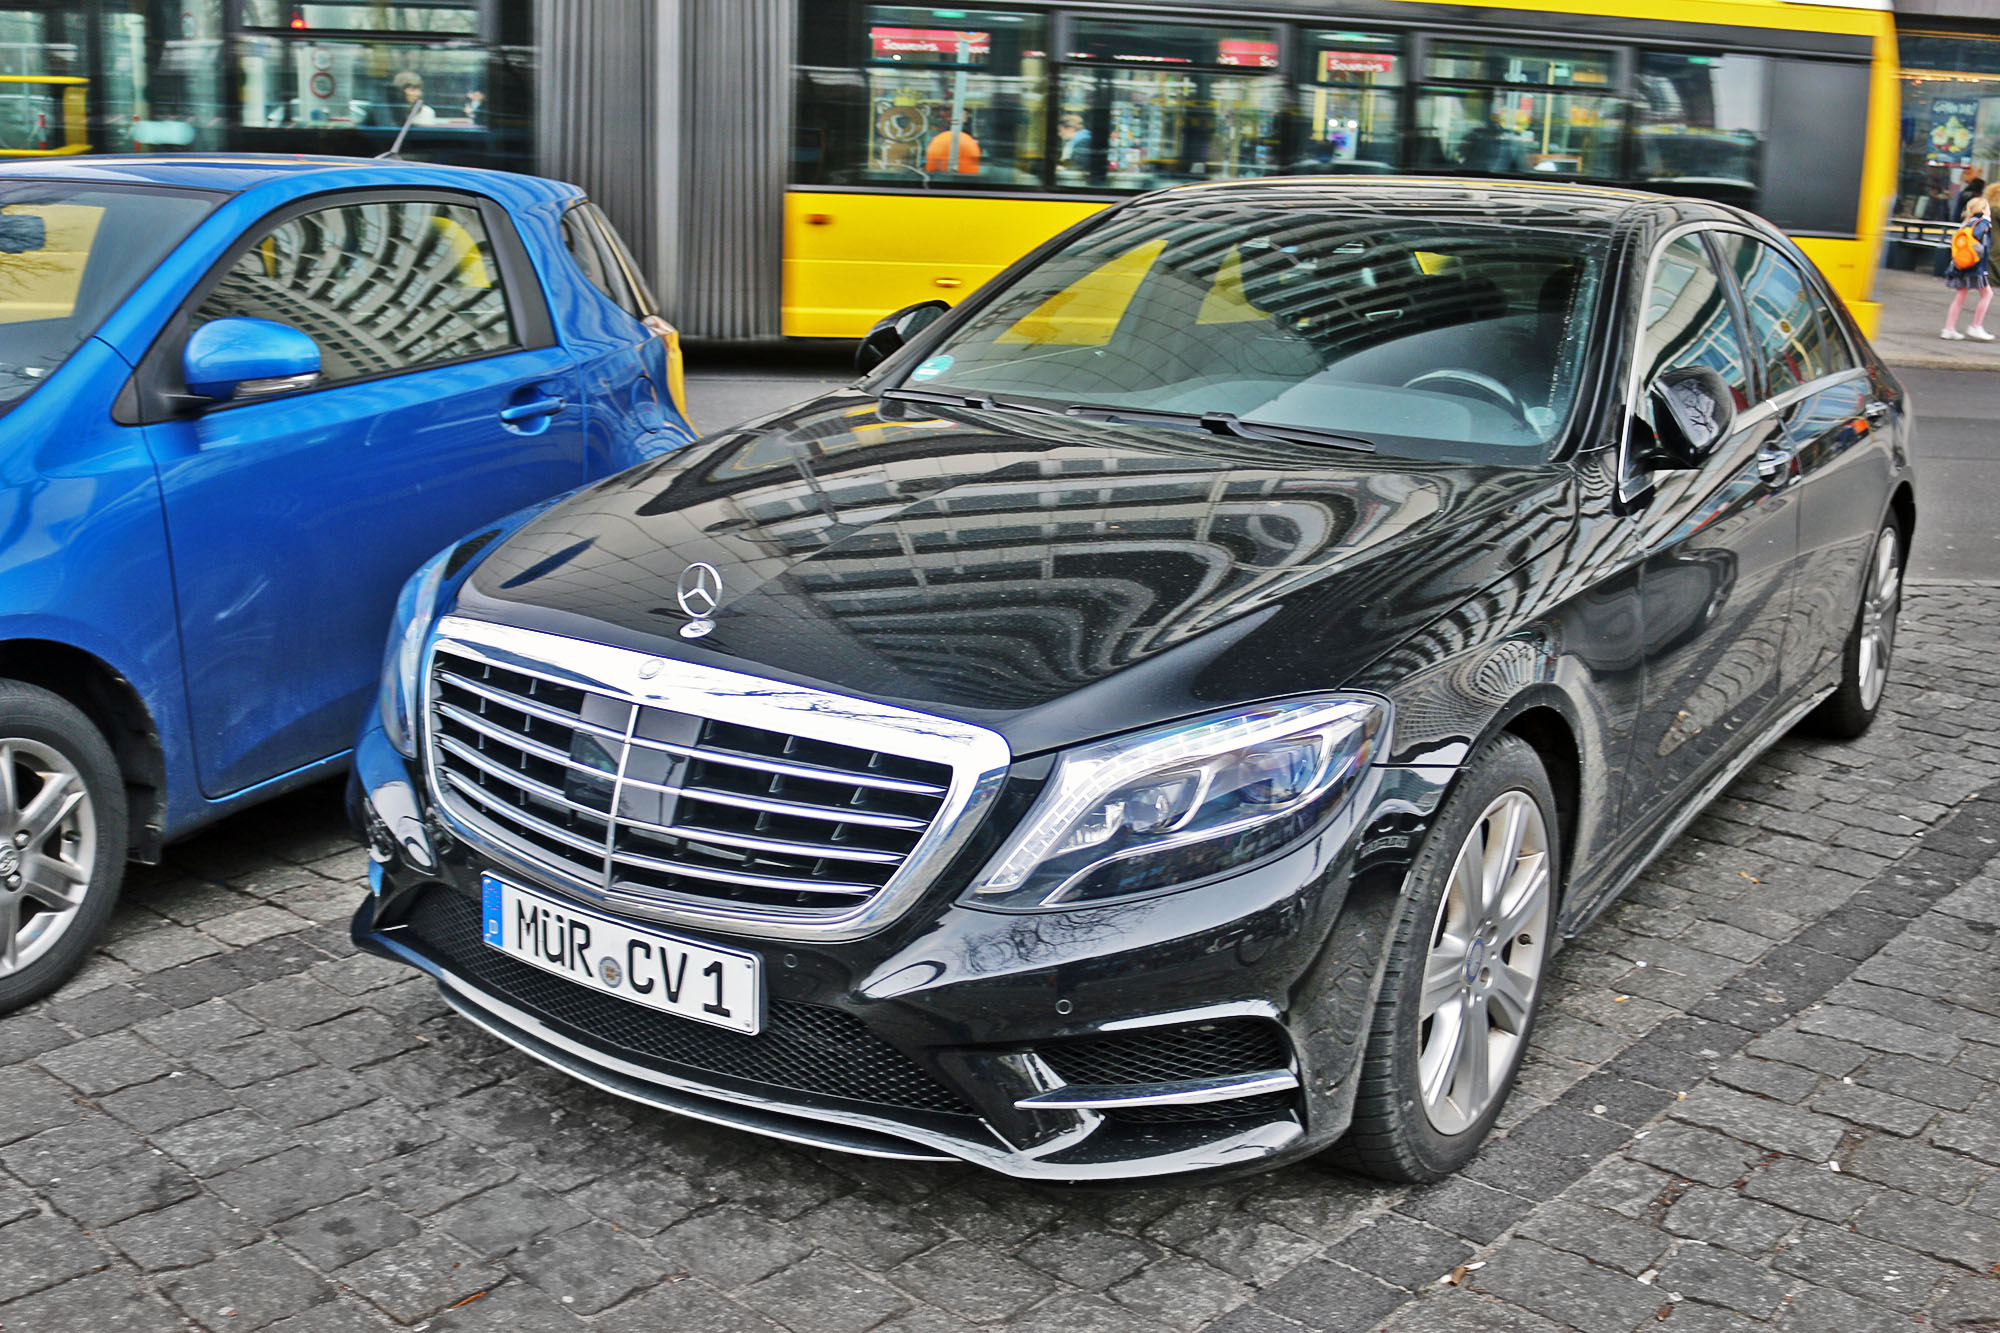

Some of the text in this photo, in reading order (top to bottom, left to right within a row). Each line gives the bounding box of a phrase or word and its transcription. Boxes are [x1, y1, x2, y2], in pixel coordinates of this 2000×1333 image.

[516, 899, 731, 1018] MÜR CV 1
